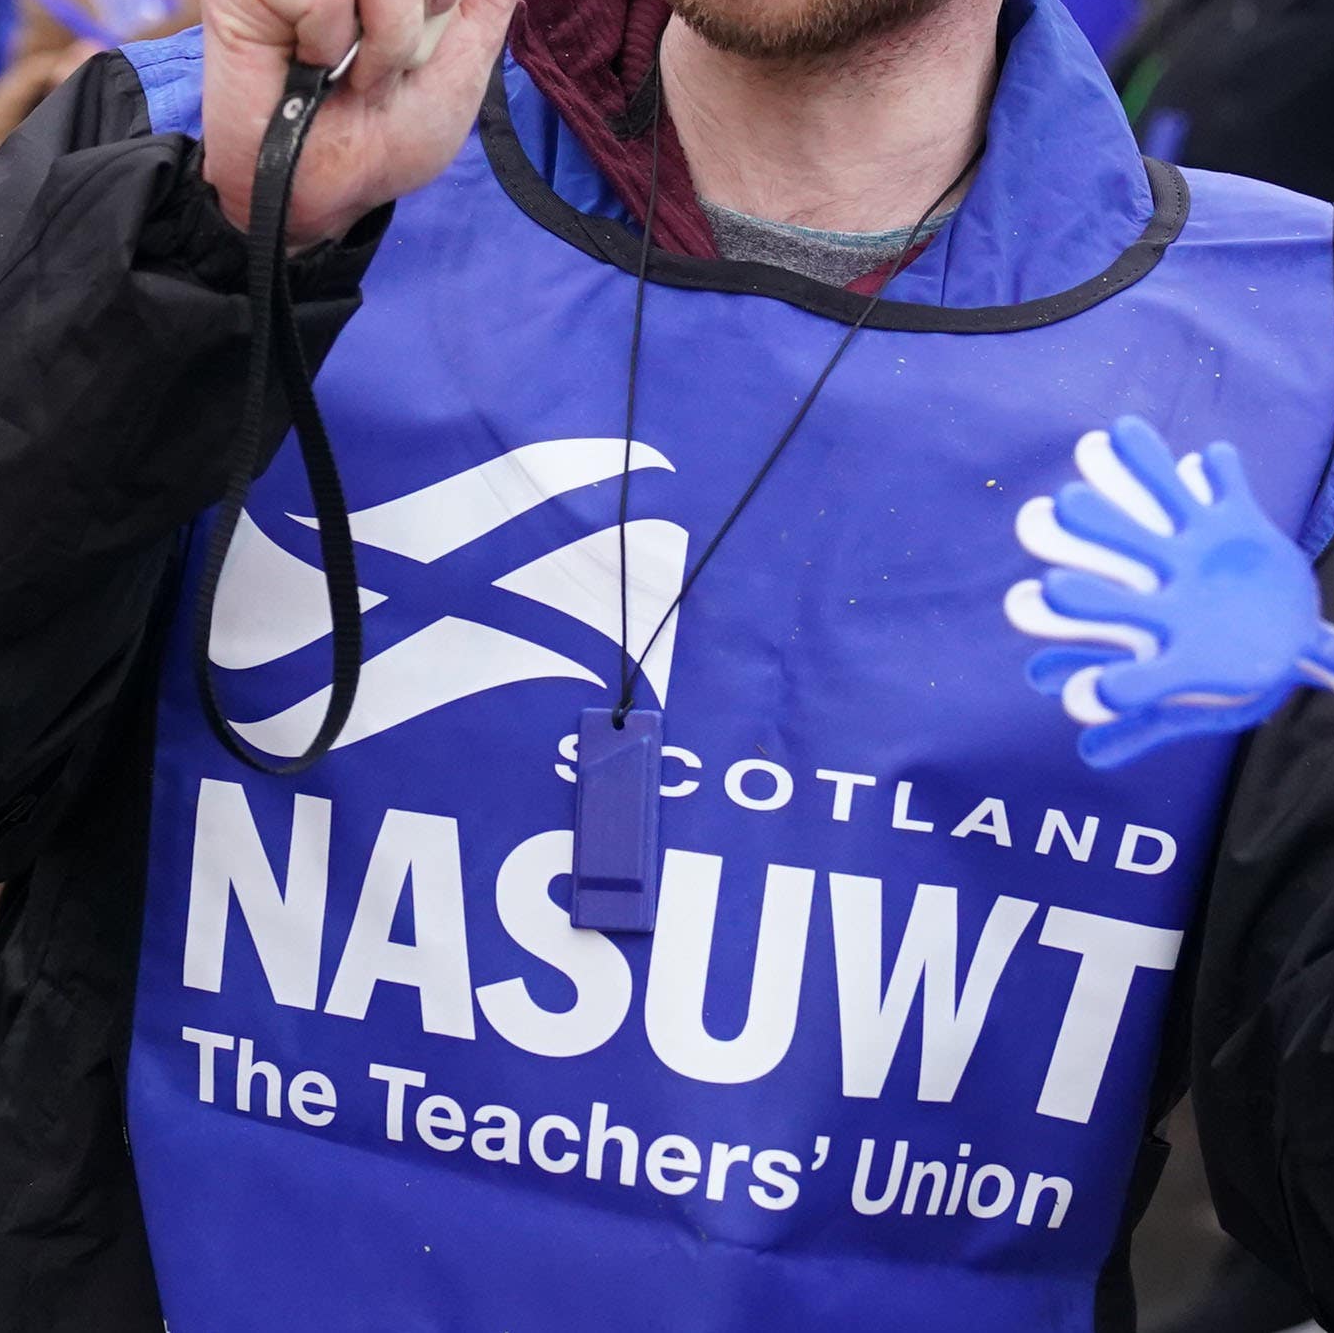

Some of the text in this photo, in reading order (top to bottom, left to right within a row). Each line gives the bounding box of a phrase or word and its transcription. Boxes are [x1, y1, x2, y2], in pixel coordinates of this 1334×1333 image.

[183, 778, 1183, 1124] NASUWT
[183, 1026, 1073, 1229] The Teachers' Union
